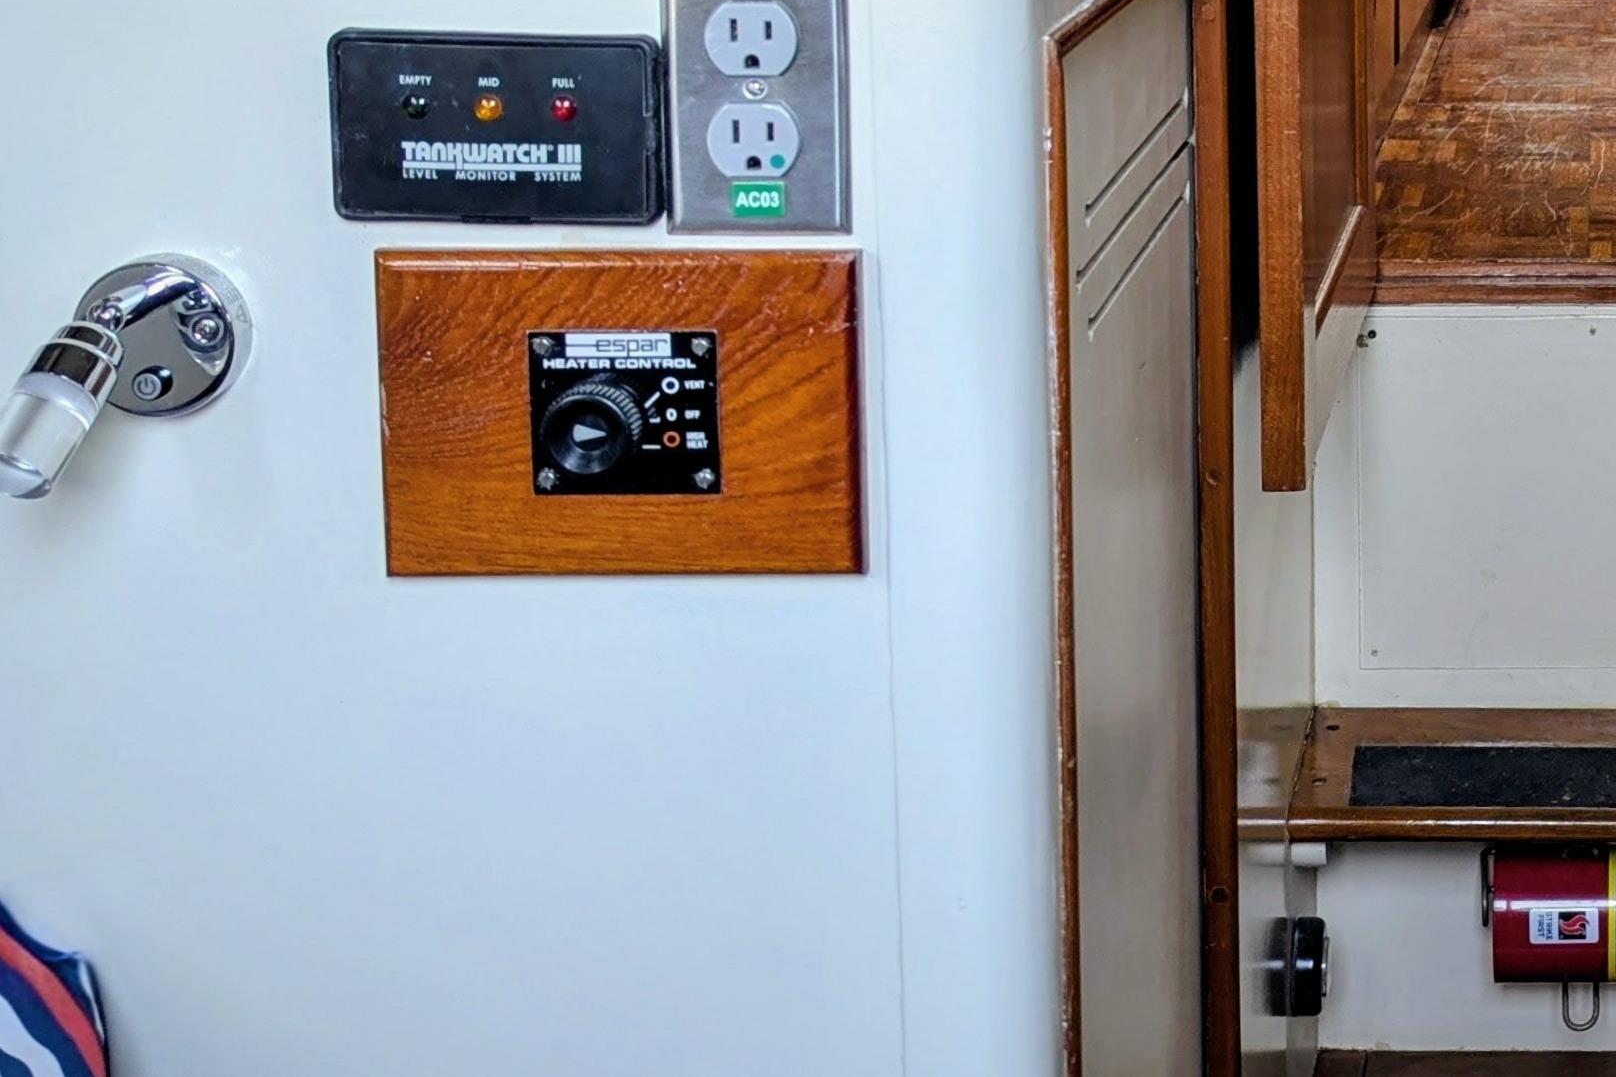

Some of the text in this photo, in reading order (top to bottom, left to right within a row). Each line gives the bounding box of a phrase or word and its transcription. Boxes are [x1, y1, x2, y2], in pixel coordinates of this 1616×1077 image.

[399, 75, 432, 86] EMPTY
[478, 77, 500, 87] MID
[552, 78, 575, 88] FULL
[557, 143, 582, 164] III
[402, 169, 582, 182] LEVEL MONITOR SYSTEM
[735, 190, 780, 208] AC03
[595, 339, 668, 357] espar
[542, 358, 697, 370] HEATER CONTROL
[684, 379, 706, 390] VENT
[684, 409, 701, 420] OFF
[1537, 914, 1545, 938] FIRST
